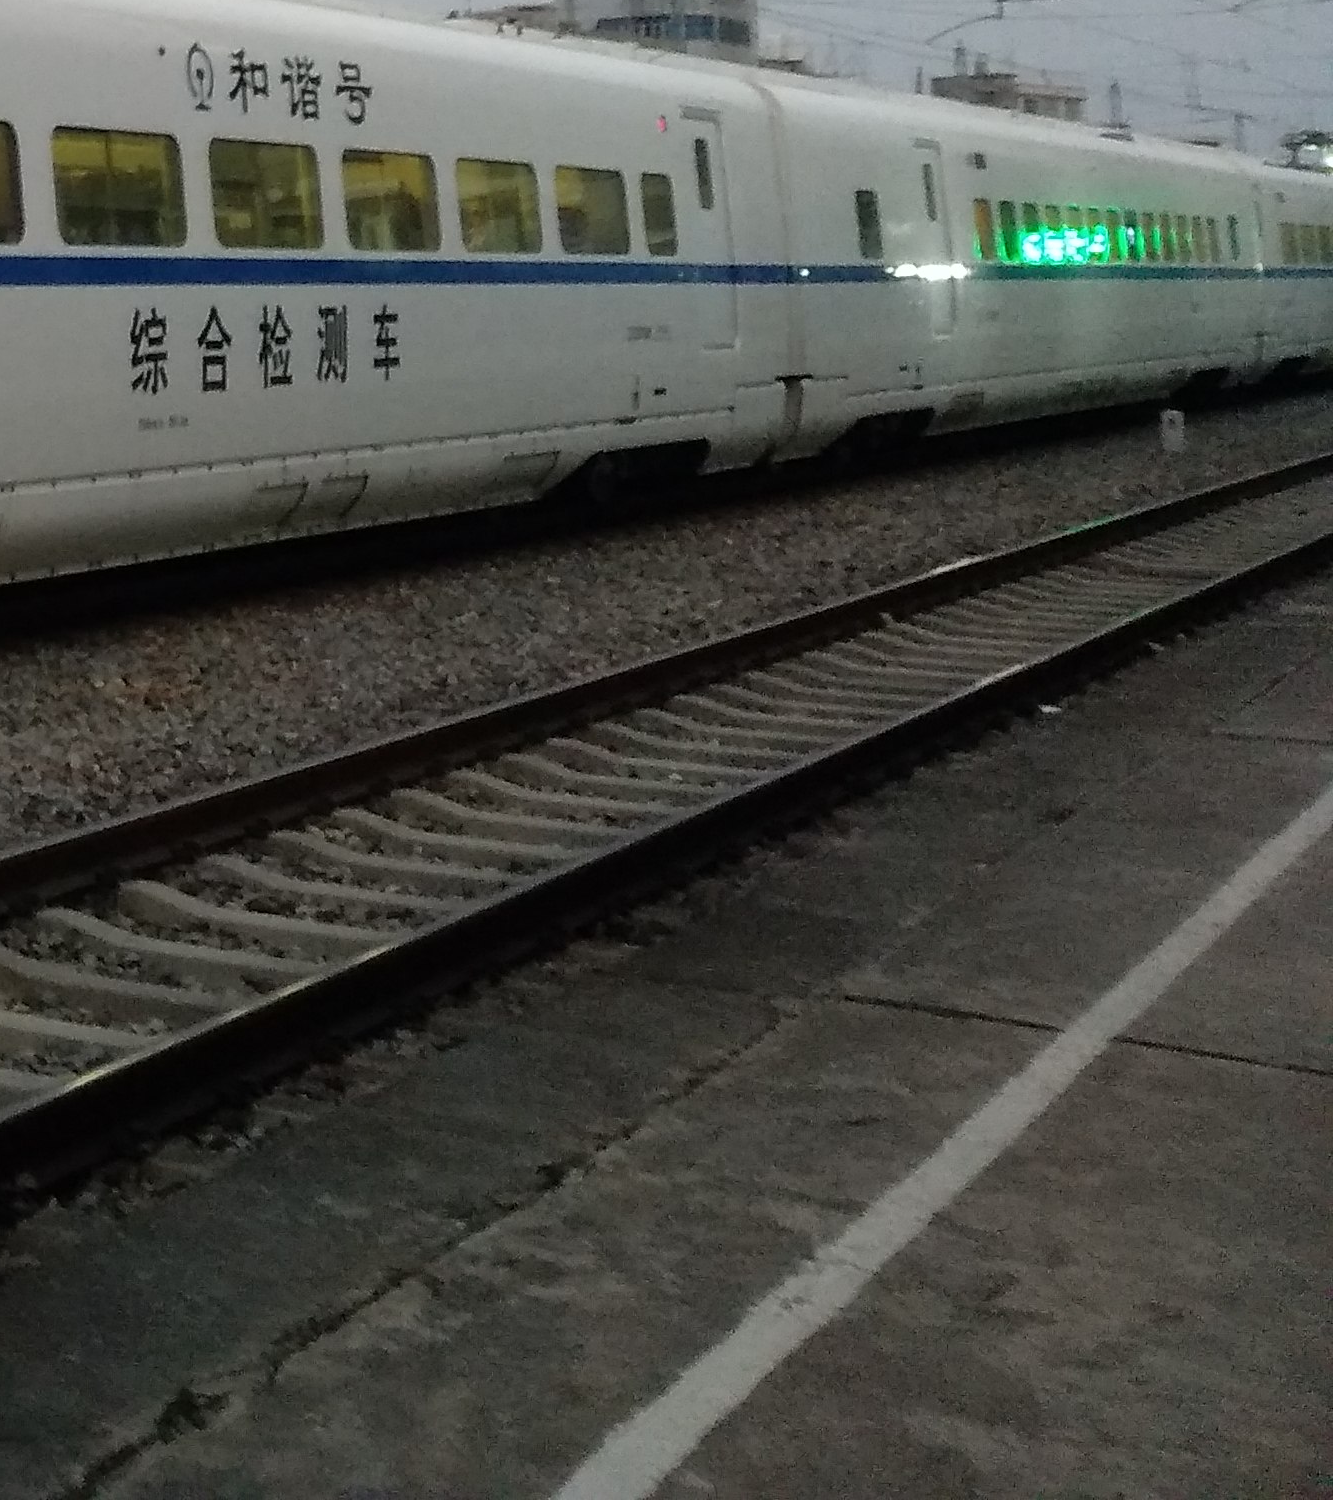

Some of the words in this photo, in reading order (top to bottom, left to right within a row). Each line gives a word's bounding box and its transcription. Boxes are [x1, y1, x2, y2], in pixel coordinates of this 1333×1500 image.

[229, 48, 372, 124] 和谐号
[130, 303, 401, 394] 综合检测车
